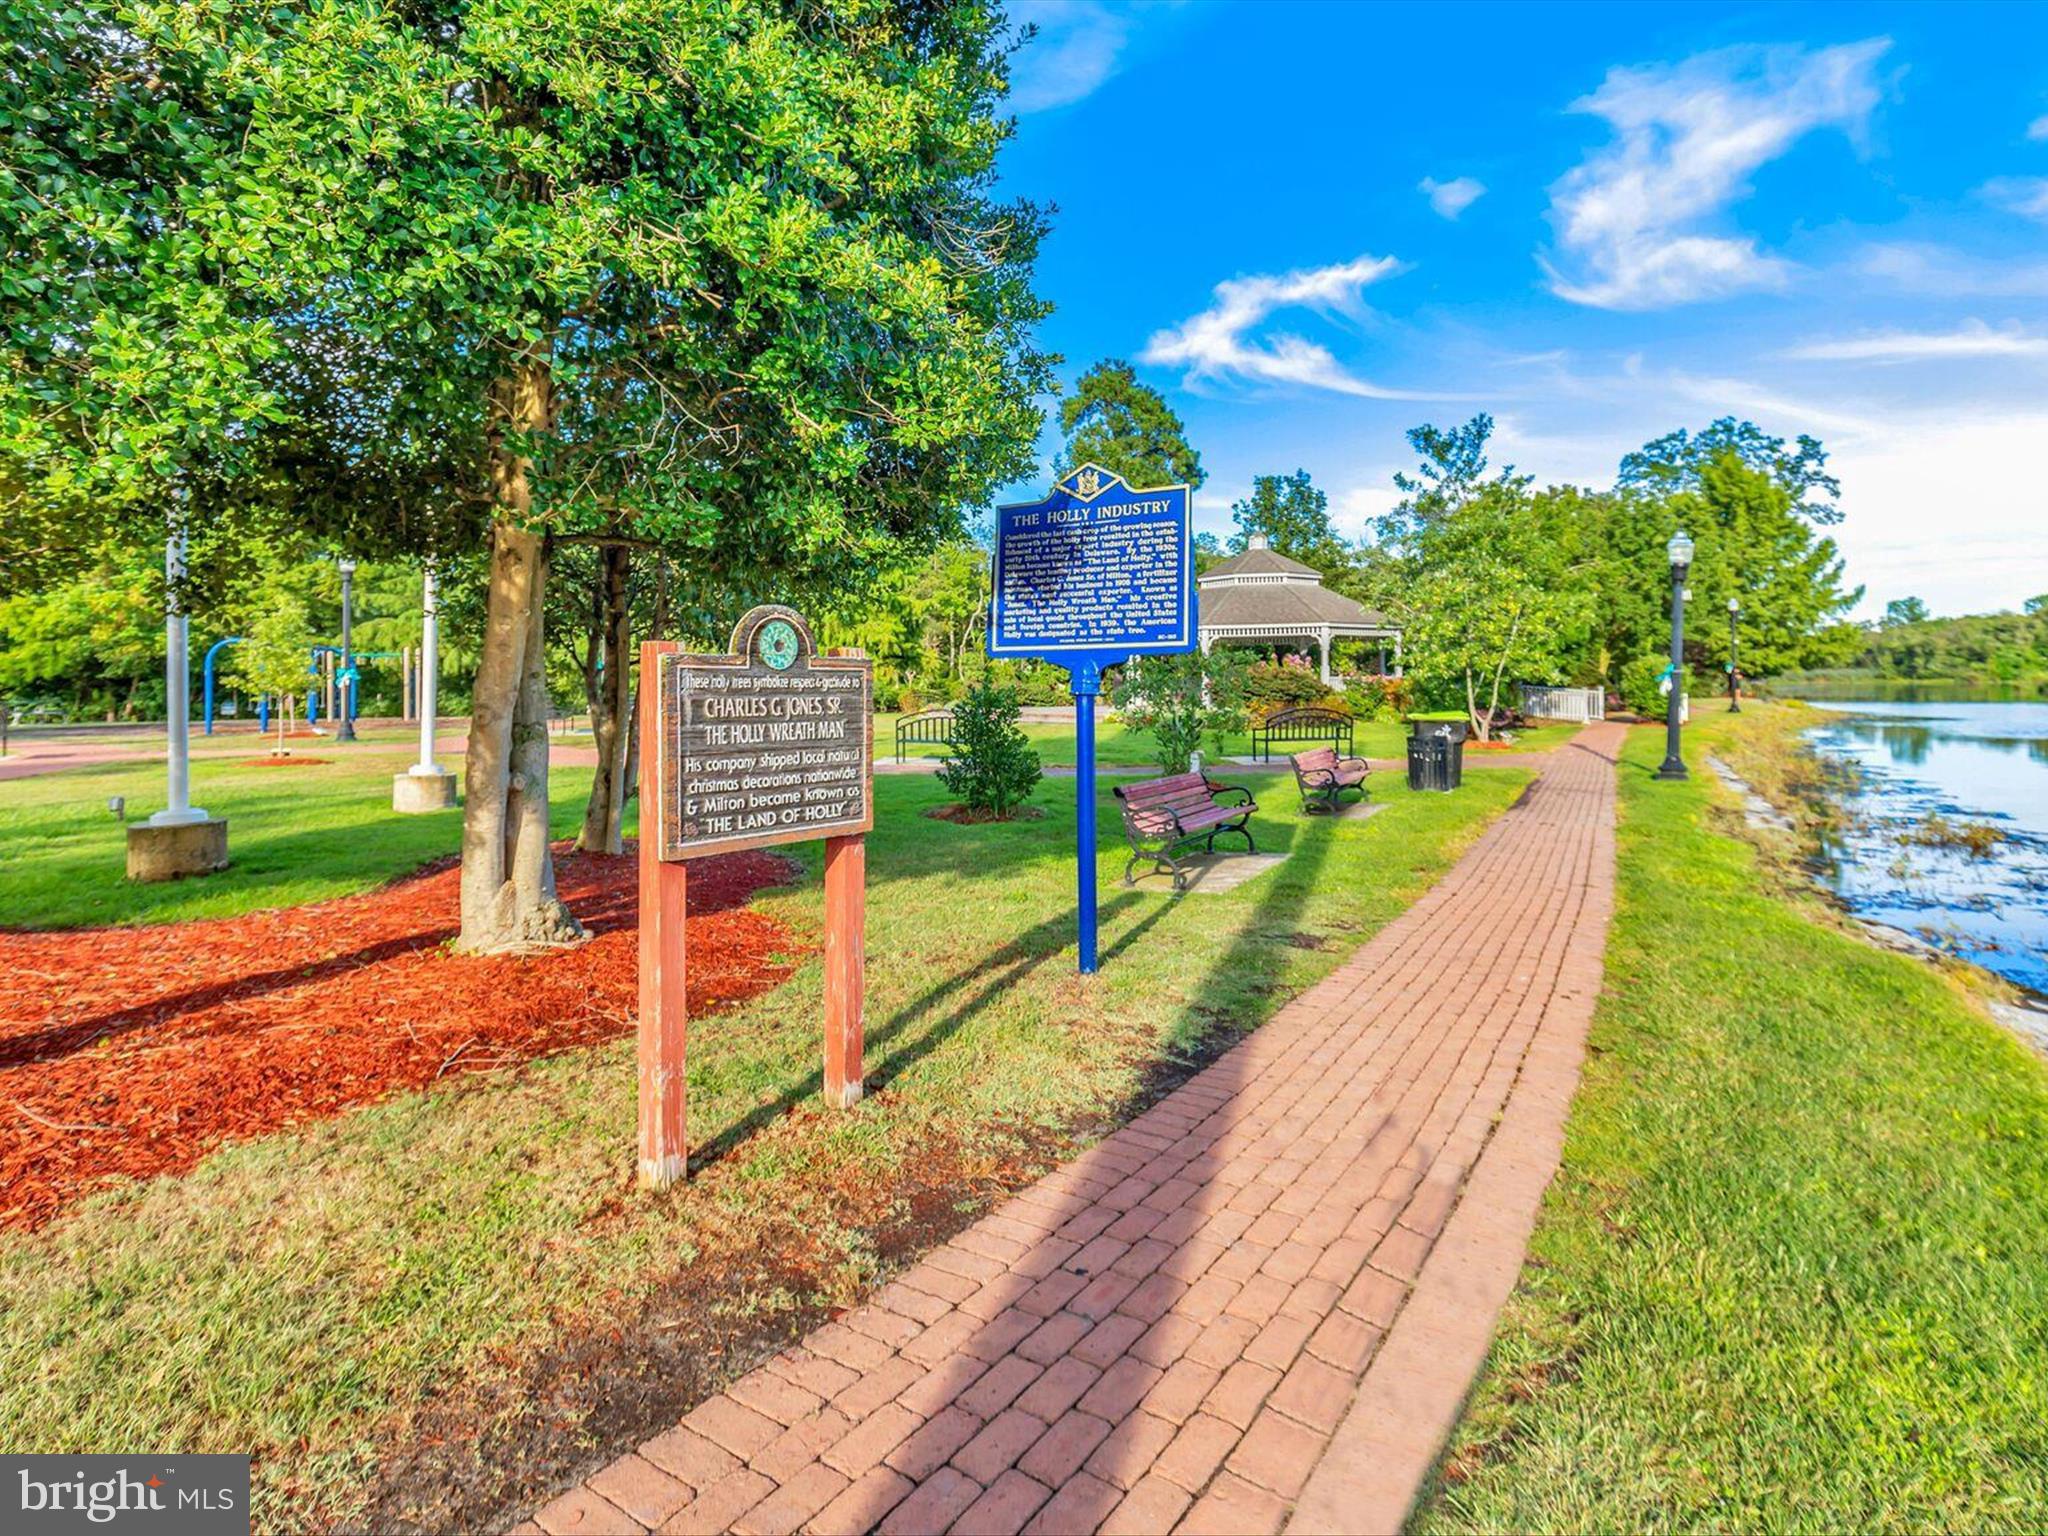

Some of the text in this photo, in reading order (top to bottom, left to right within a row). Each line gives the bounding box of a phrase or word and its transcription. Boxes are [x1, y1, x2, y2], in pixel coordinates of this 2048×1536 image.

[1012, 500, 1171, 526] THE HOLLY INDUSTRY
[1138, 538, 1163, 546] during
[753, 674, 788, 692] symbolize
[790, 676, 815, 692] respect
[705, 696, 844, 720] CHARLES G. JONES, SR.
[731, 723, 765, 744] HOLLY
[769, 721, 816, 742] WREATH
[685, 749, 860, 774] His company shipped local natual
[689, 767, 857, 794] christmas decorations nationwide
[686, 787, 859, 814] & Milton became known as
[738, 811, 775, 829] LAND
[782, 808, 800, 823] OF
